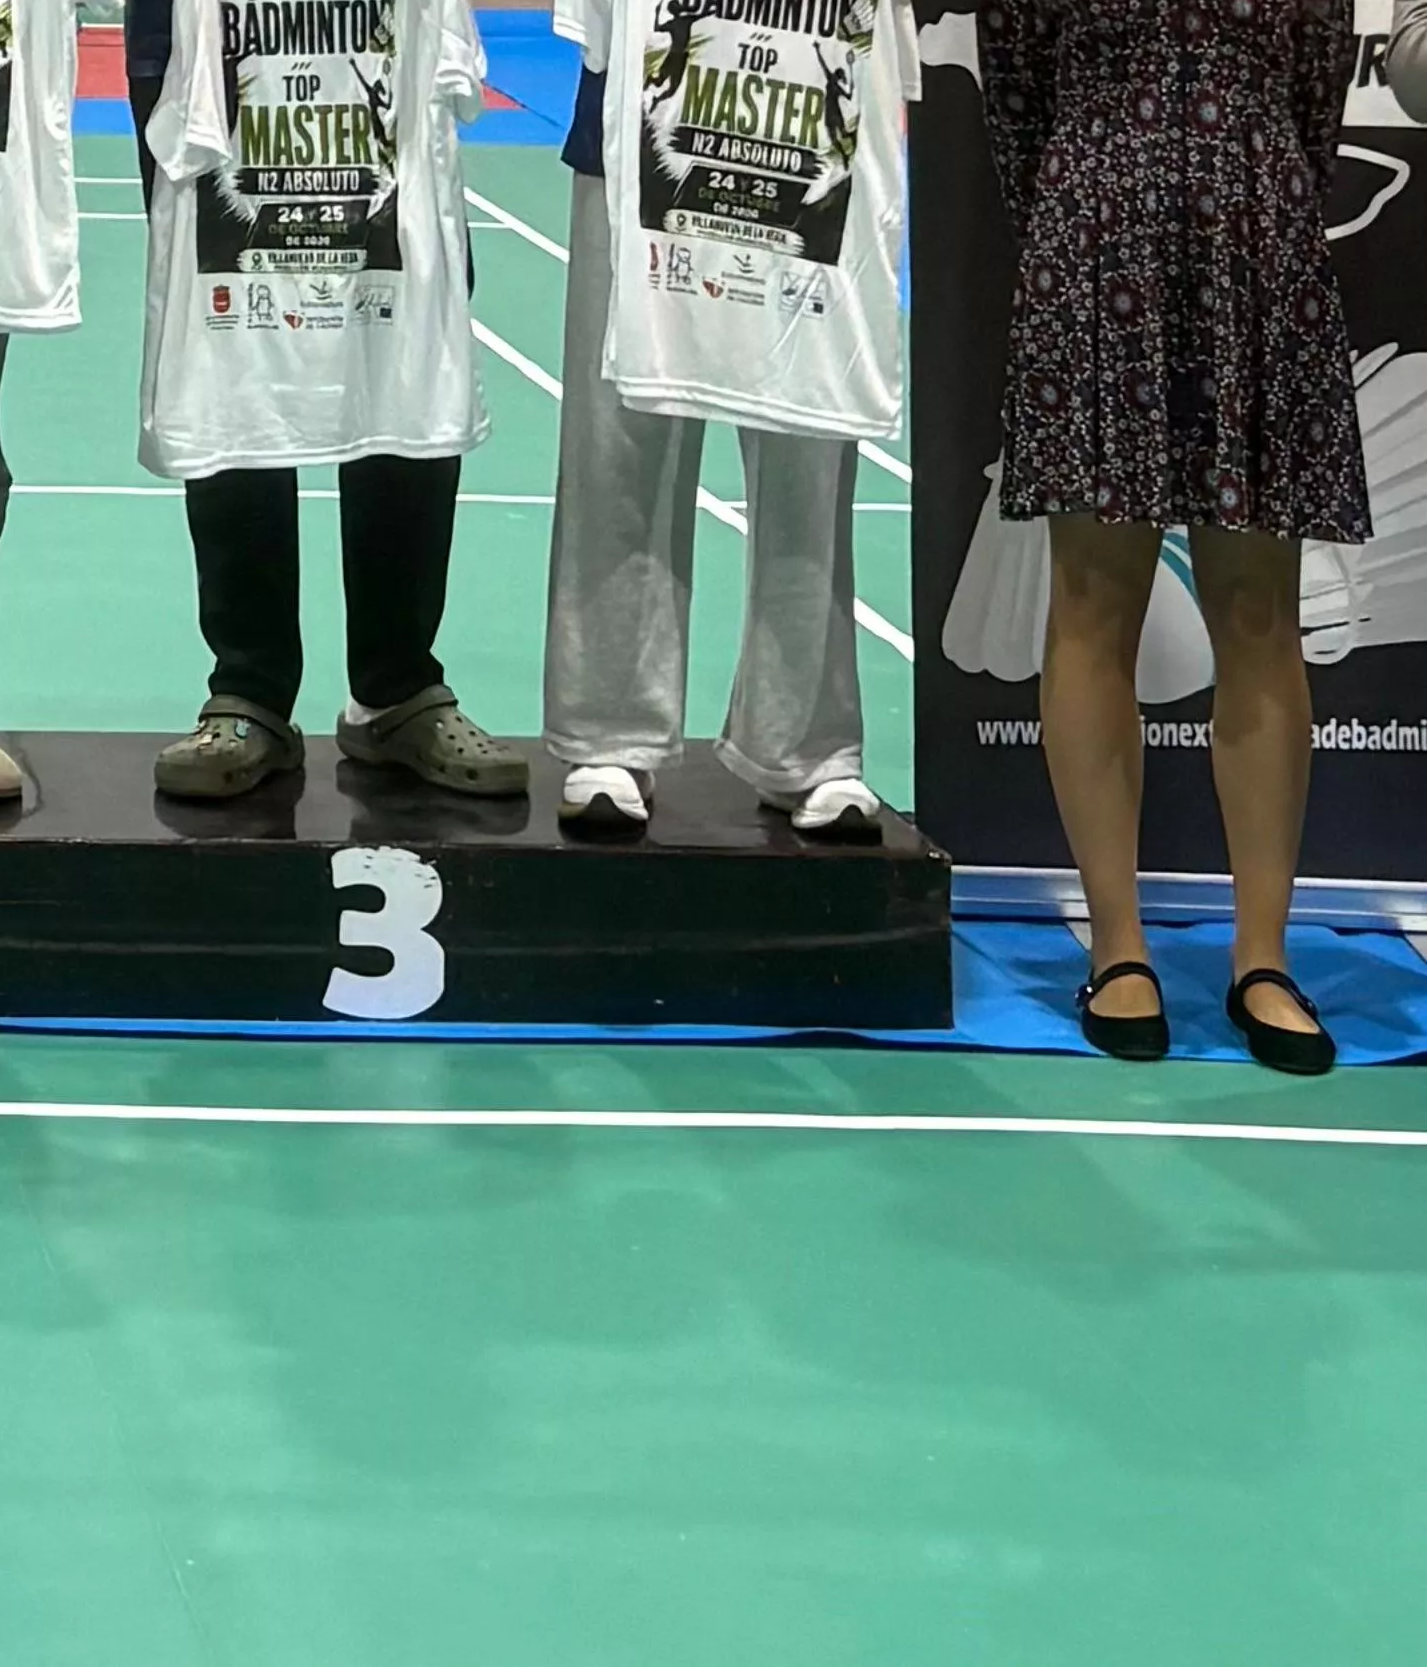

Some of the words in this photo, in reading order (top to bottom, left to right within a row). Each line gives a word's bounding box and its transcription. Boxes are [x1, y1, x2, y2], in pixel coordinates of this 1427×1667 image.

[738, 43, 778, 73] TOP
[283, 75, 321, 102] TOP
[681, 65, 825, 149] MASTER
[241, 104, 371, 166] MASTER
[283, 171, 360, 192] ABSOLUTO
[325, 845, 448, 1020] 3
